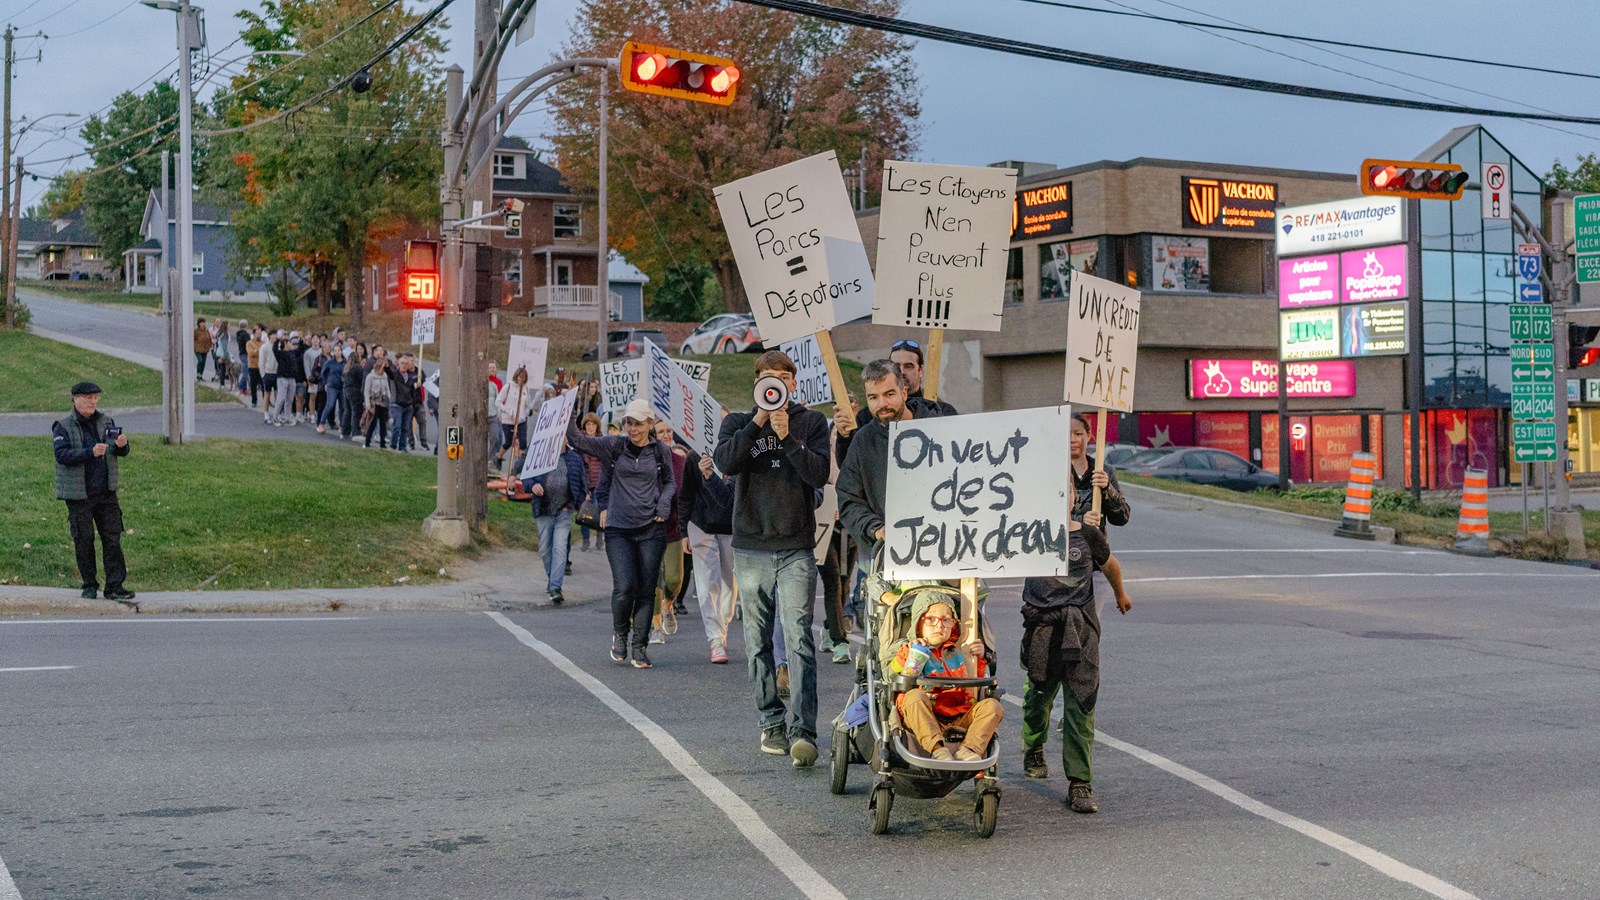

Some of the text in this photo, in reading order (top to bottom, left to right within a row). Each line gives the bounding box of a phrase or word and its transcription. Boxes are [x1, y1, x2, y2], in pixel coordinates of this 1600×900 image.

[887, 166, 1006, 204] Les Citoyens
[1222, 182, 1274, 200] VACHON
[1024, 184, 1068, 206] VACHON
[738, 184, 804, 228] Les
[1240, 208, 1248, 216] de
[1248, 208, 1275, 218] conduite
[926, 206, 972, 232] N'en
[1222, 218, 1254, 227] supérieure
[1296, 211, 1341, 228] RE/MAX
[1340, 204, 1396, 221] Avantages
[756, 228, 820, 260] Parcs
[1311, 229, 1364, 242] 418 221-0101
[1578, 238, 1600, 249] FLÉCH
[908, 232, 990, 268] Peuvent
[1292, 260, 1328, 274] Articles
[1521, 257, 1538, 272] 73
[408, 278, 434, 299] 20
[918, 272, 954, 298] Plus
[1299, 276, 1322, 290] pour
[764, 278, 862, 319] Dépotoirs
[1287, 319, 1334, 344] JDM
[1512, 320, 1529, 334] 173
[1534, 320, 1550, 334] 173
[1095, 327, 1114, 362] DE
[1512, 350, 1530, 358] NORD
[1534, 350, 1551, 358] SUD
[604, 361, 628, 374] LES
[800, 372, 828, 404] BOUGE
[1078, 357, 1129, 407] TAXE
[1514, 400, 1532, 414] 204
[1534, 400, 1553, 414] 204
[1516, 428, 1532, 438] EST
[1536, 426, 1554, 437] OUEST
[893, 428, 1029, 470] On veut
[931, 467, 1014, 516] des
[890, 516, 978, 567] Jeux
